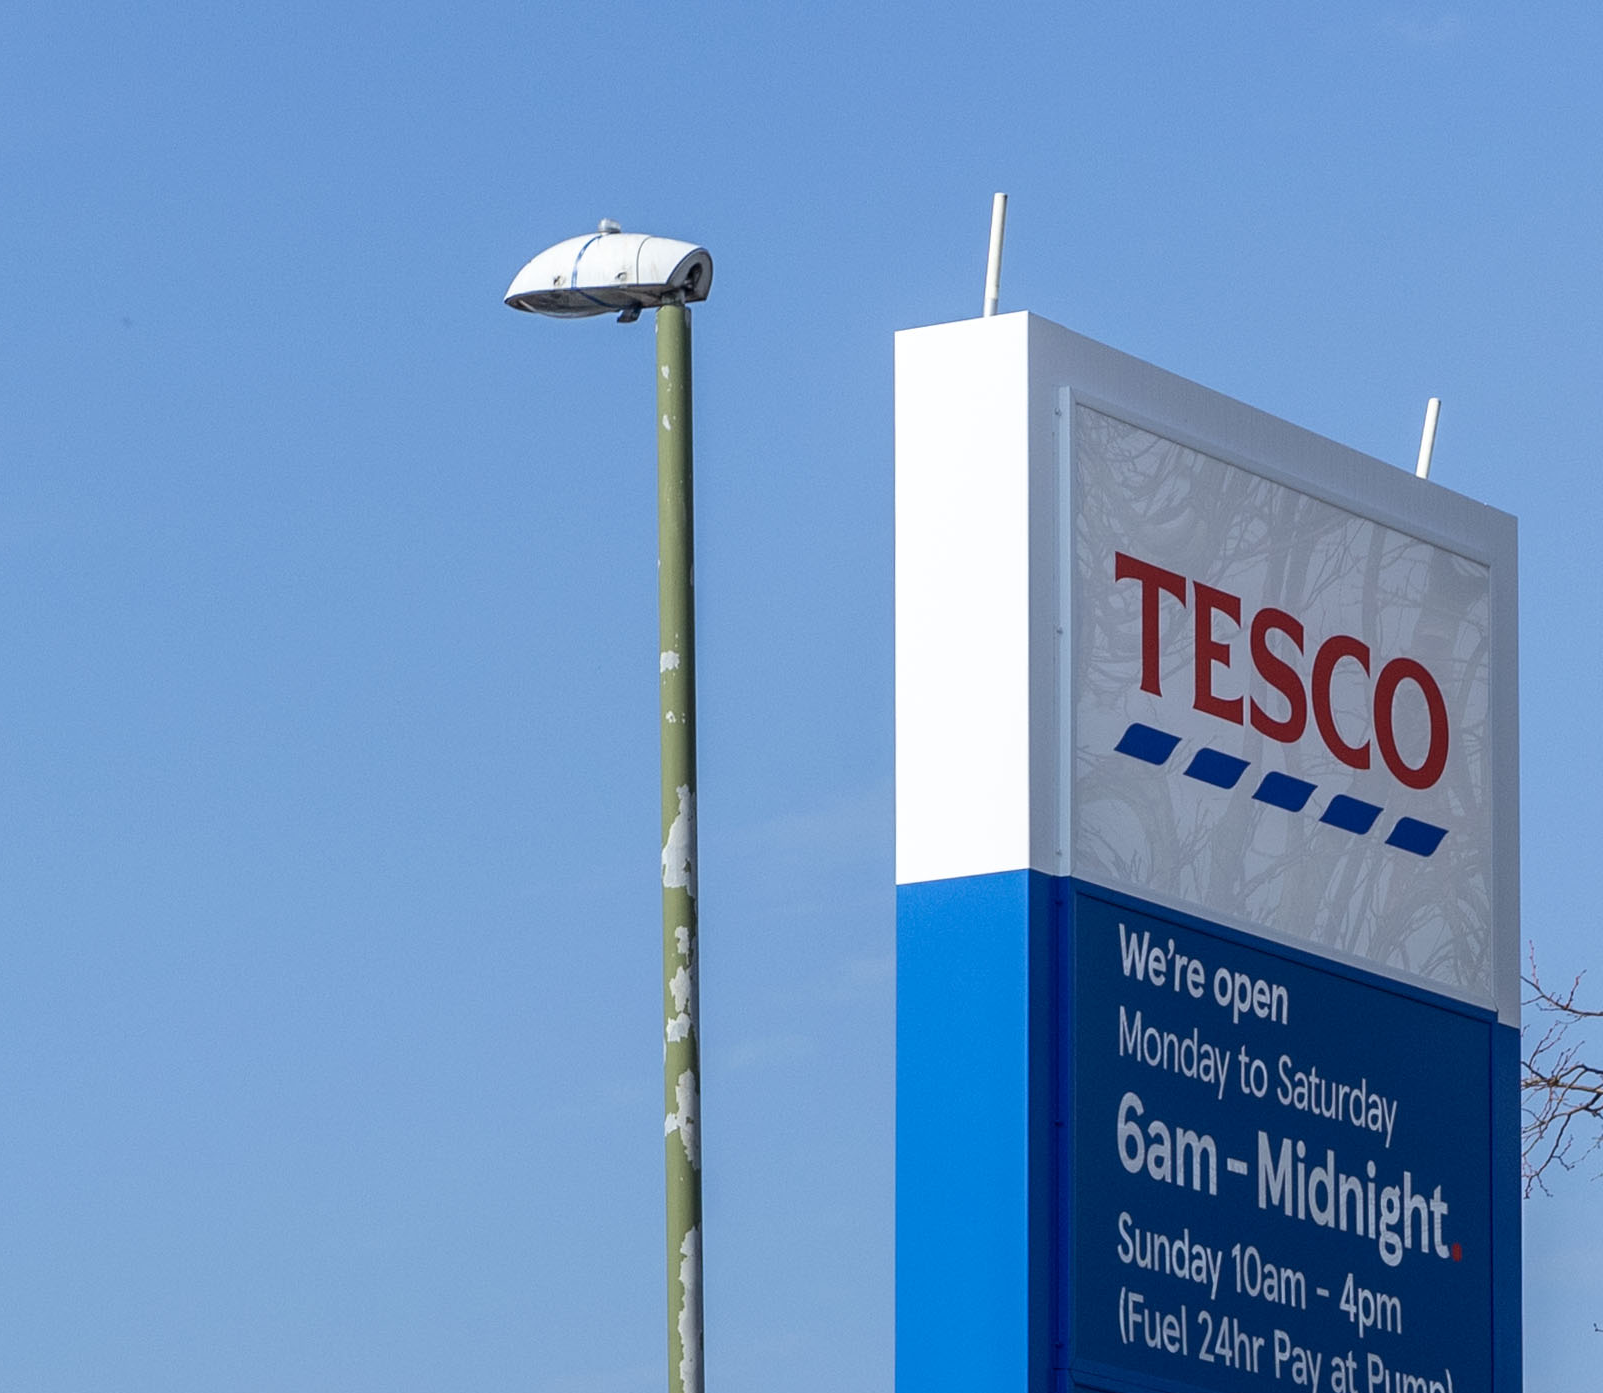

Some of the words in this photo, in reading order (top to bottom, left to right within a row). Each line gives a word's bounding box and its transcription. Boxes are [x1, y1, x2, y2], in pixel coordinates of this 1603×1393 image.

[1115, 551, 1451, 791] TESCO
[1119, 923, 1205, 998] We're
[1213, 967, 1289, 1025] open
[1119, 1005, 1231, 1100] Monday
[1238, 1045, 1268, 1098] to
[1277, 1054, 1398, 1148] Saturday
[1117, 1211, 1223, 1300] Sunday
[1231, 1243, 1306, 1310] 10am
[1339, 1273, 1402, 1339] 4pm
[1118, 1286, 1188, 1356] (Fuel
[1197, 1309, 1265, 1374] 24hr
